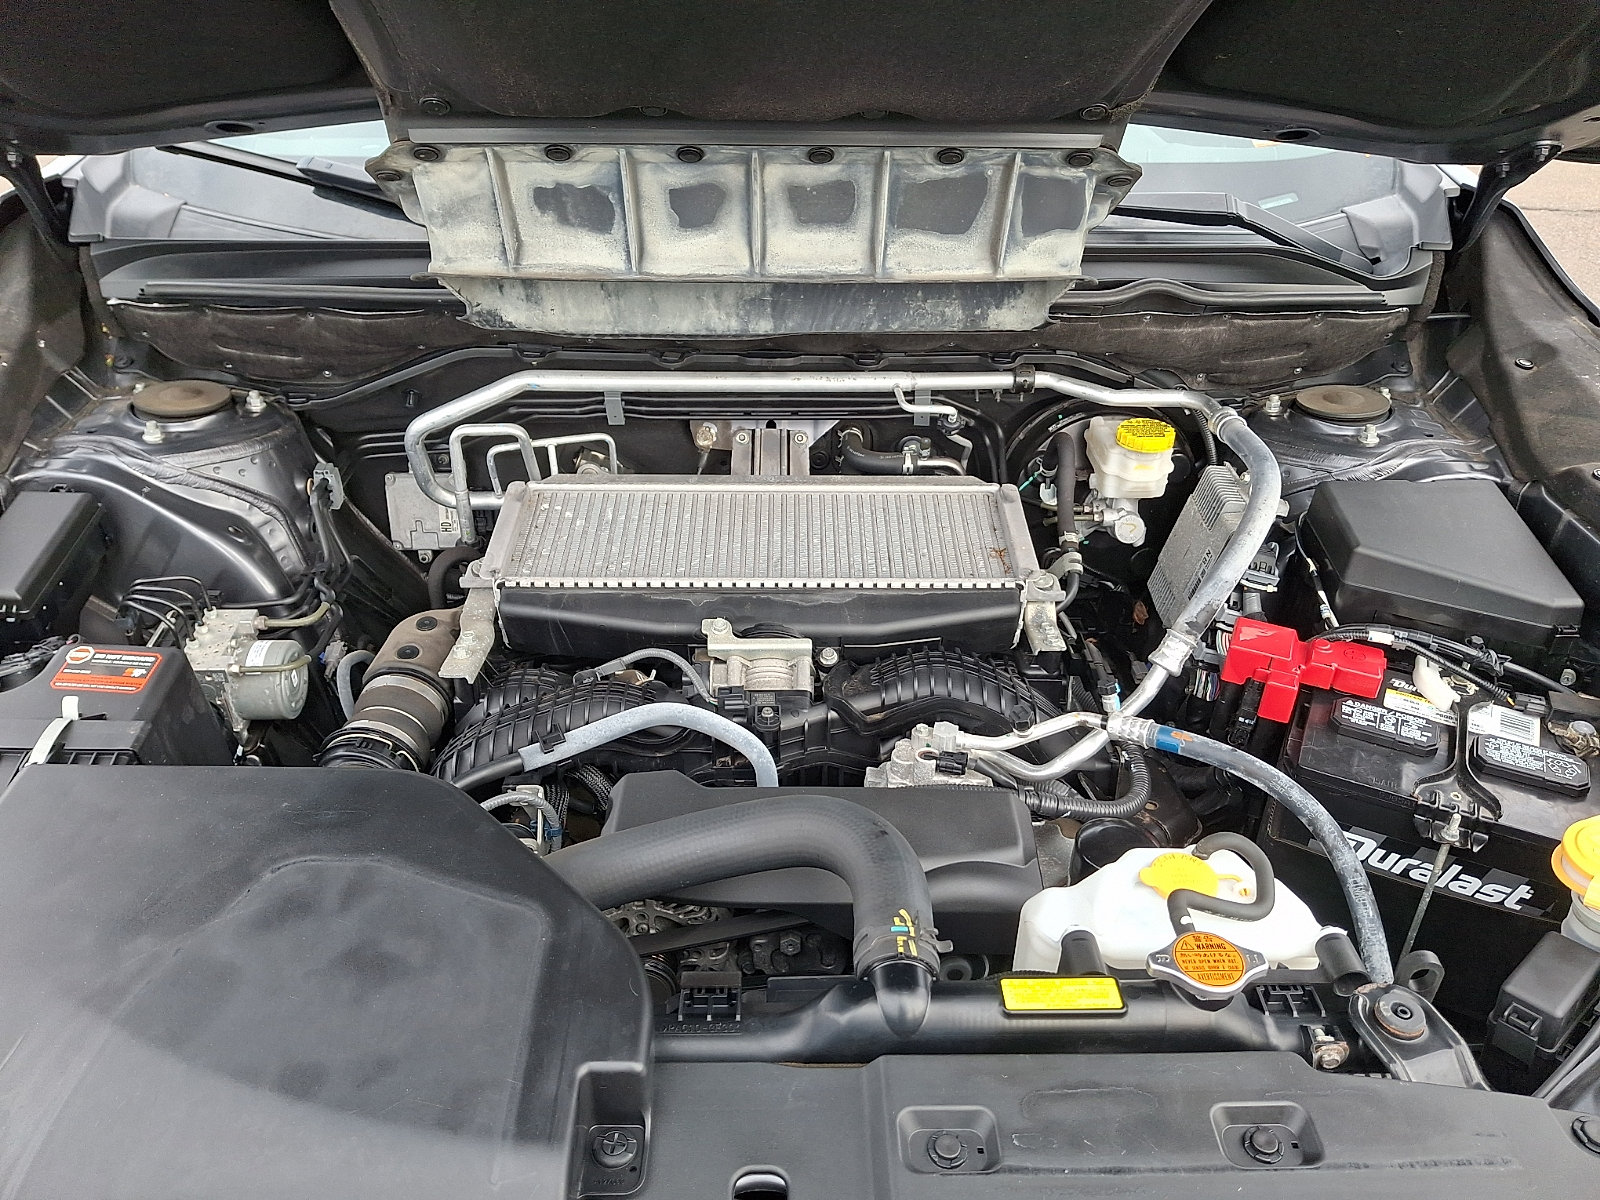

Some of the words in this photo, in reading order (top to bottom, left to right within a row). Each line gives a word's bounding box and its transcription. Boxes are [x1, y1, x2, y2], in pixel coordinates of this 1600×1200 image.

[441, 521, 452, 532] HD
[1395, 713, 1427, 725] POISON
[1343, 830, 1533, 911] Duralast
